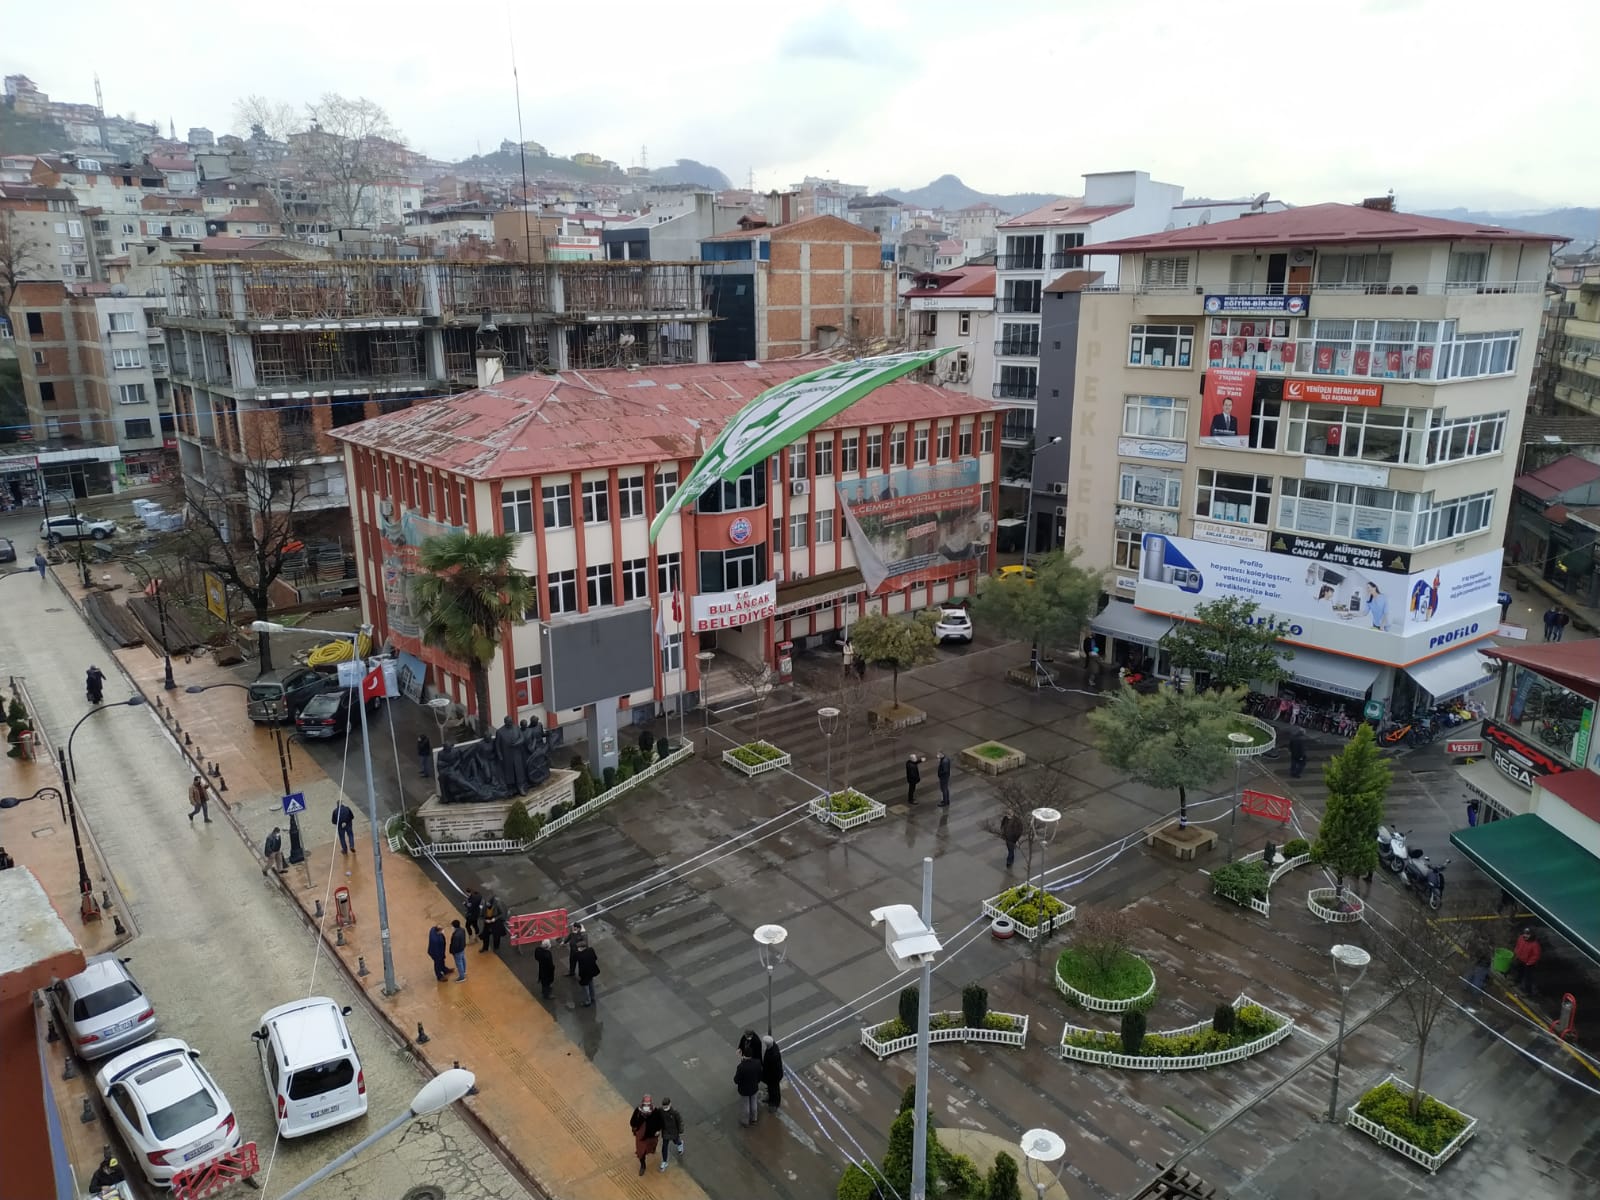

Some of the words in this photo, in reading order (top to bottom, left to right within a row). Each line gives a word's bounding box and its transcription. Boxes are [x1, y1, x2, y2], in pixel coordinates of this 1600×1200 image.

[1306, 384, 1332, 394] YENİDEN
[1333, 385, 1353, 396] REFAH
[1353, 387, 1378, 397] PARTİSİ
[938, 487, 975, 498] OLSUN
[1291, 547, 1319, 558] CANSU
[1352, 557, 1384, 569] ÇOLAK
[1334, 543, 1382, 559] MÜHENDİSİ
[1210, 561, 1246, 575] hayatınızı
[1239, 558, 1264, 570] Profilo
[1223, 574, 1251, 585] vaktiniz
[1252, 579, 1266, 587] size
[1215, 581, 1264, 596] sevdiklerinize
[709, 593, 771, 615] BULANCAK
[698, 601, 777, 631] BELEDİYESİ
[1451, 743, 1480, 752] VESTEL
[1494, 750, 1535, 787] REGA
